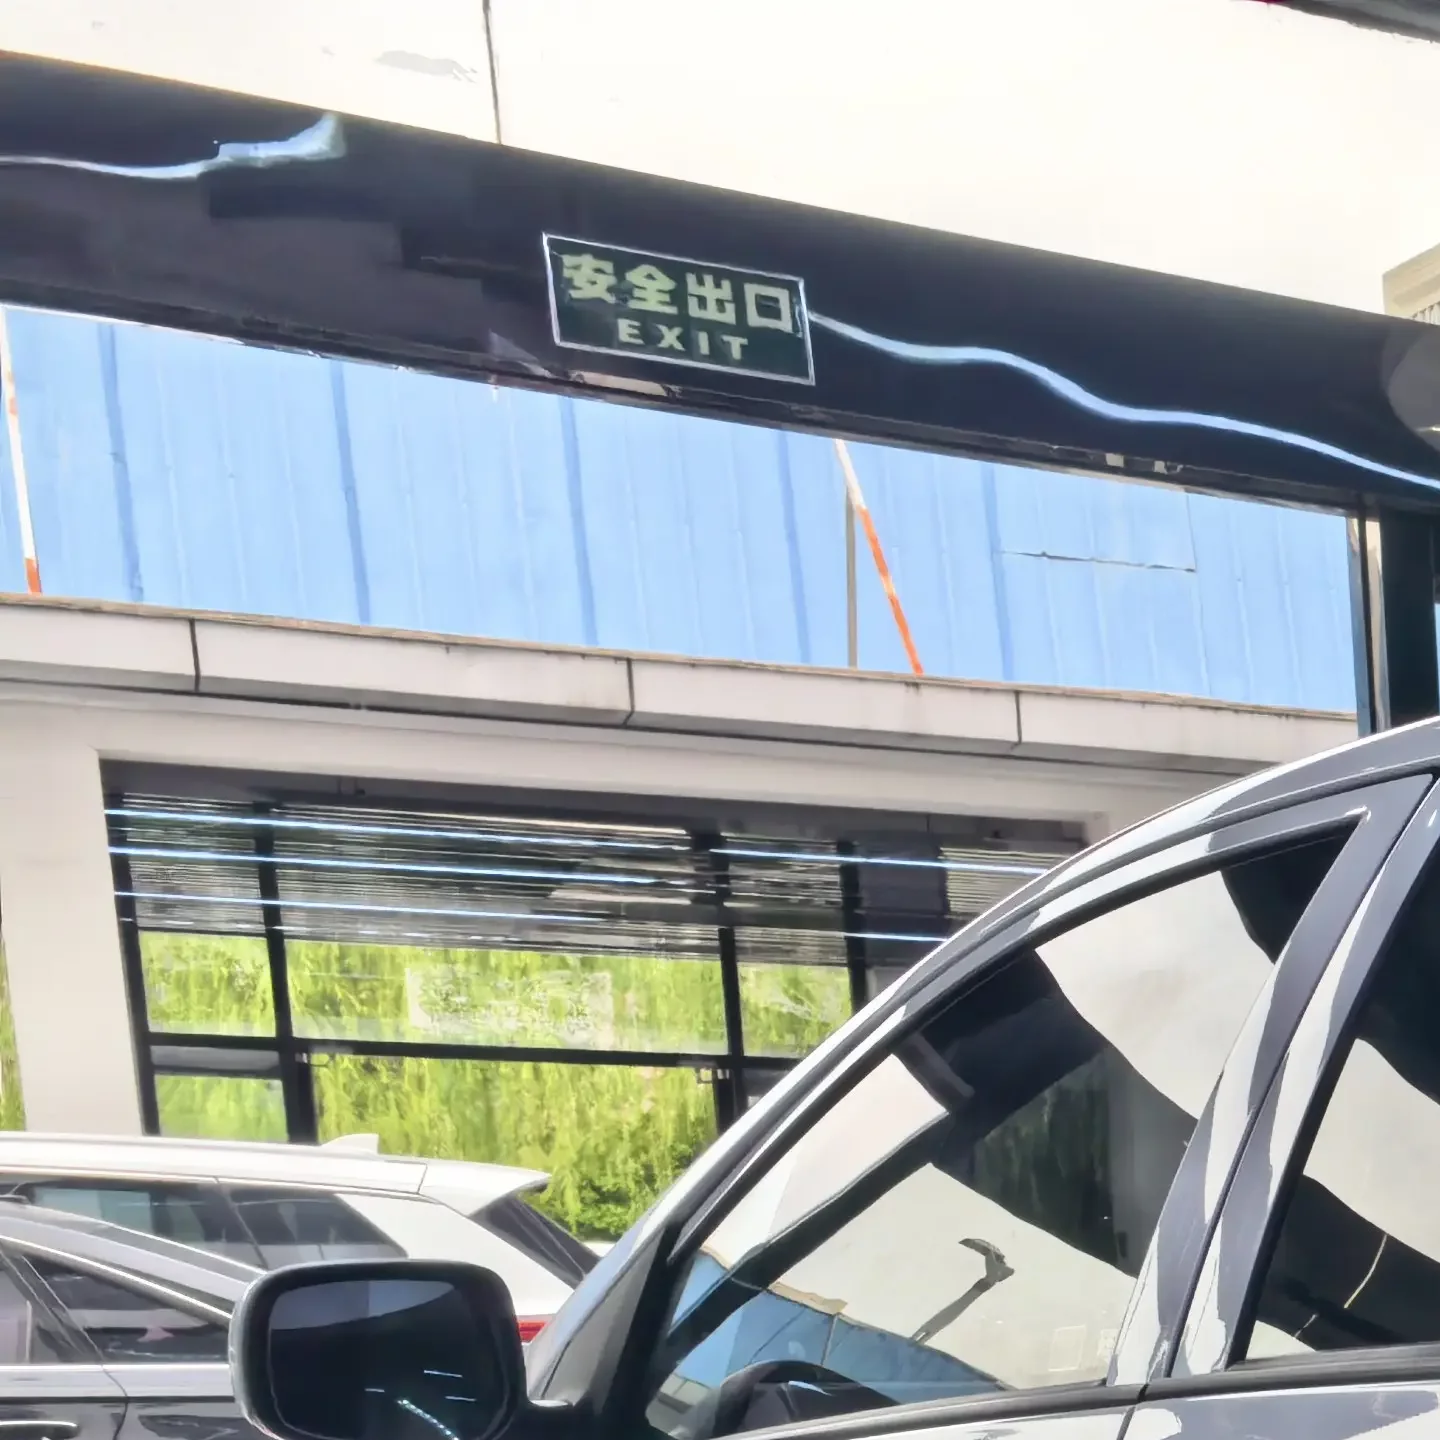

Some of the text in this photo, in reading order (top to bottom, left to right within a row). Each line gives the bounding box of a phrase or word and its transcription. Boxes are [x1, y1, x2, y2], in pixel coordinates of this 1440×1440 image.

[561, 253, 793, 333] 安全出口
[617, 318, 748, 360] EXIT
